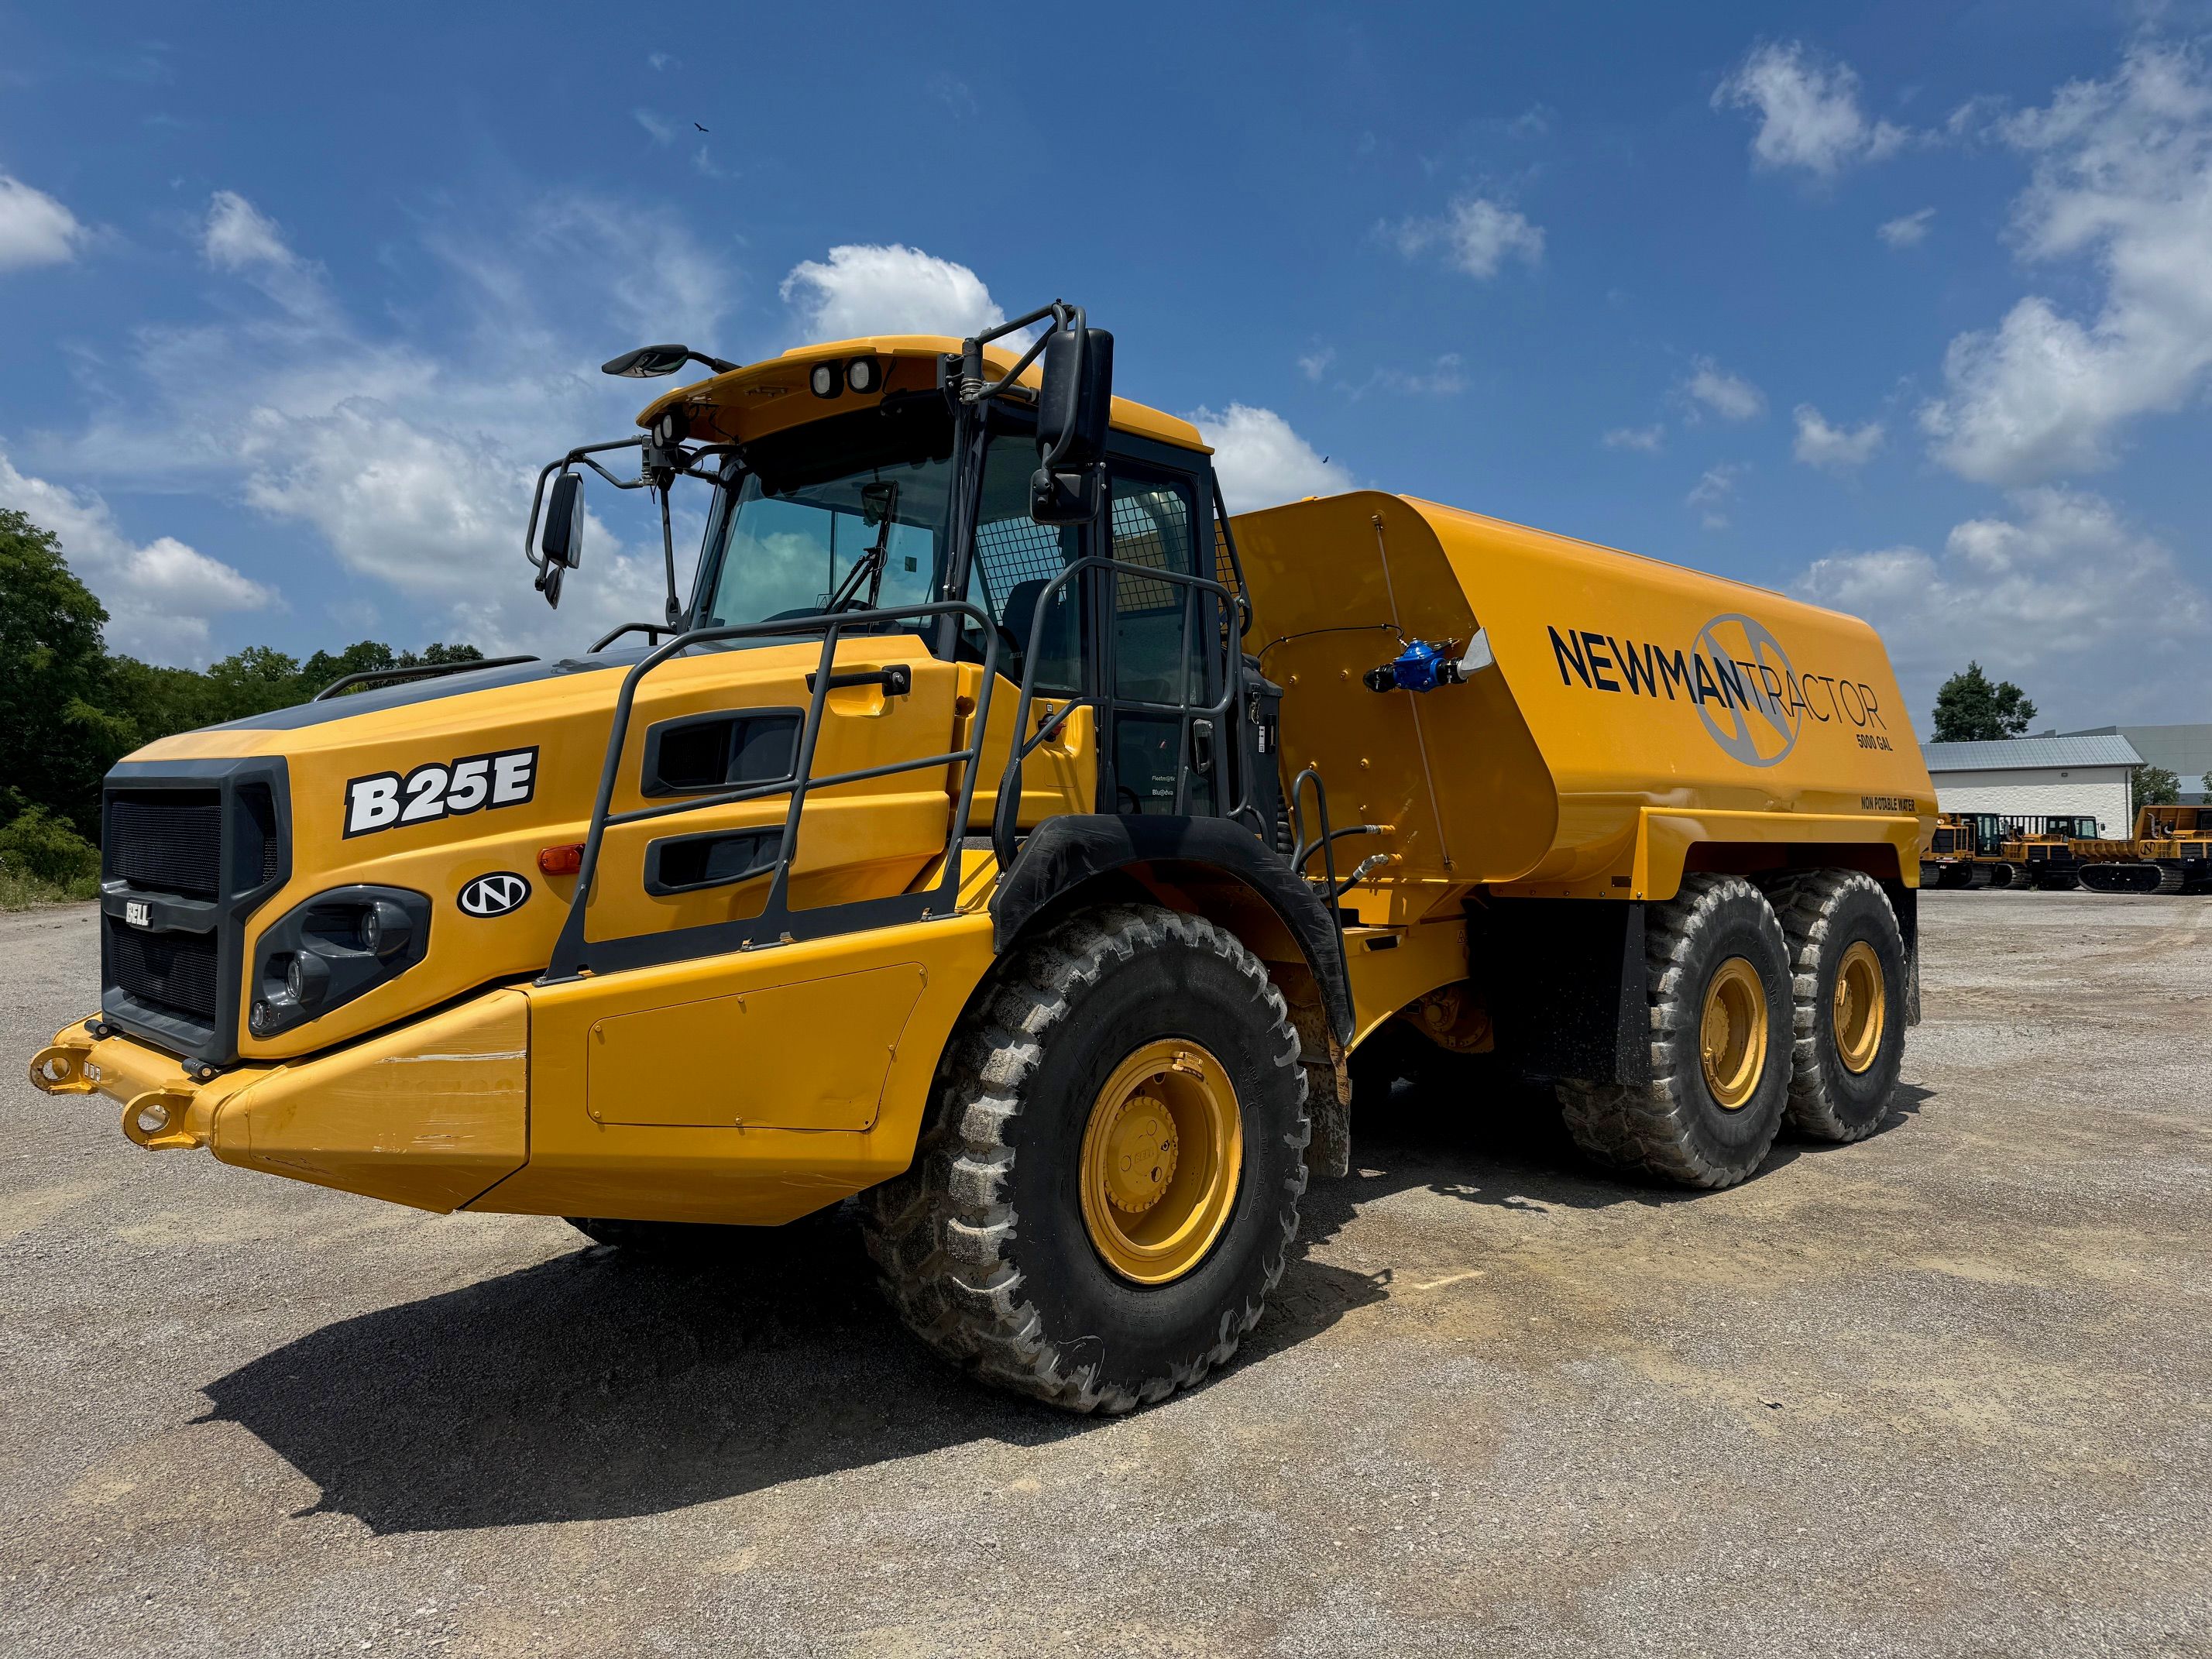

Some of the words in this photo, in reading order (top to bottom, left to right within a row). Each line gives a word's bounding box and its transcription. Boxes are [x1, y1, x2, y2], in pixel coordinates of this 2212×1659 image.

[1856, 733, 1877, 750] 5000
[1877, 736, 1894, 751] GAL
[347, 750, 535, 835] B25E
[1861, 796, 1874, 810] NON
[1874, 797, 1898, 812] POTABLE
[1898, 799, 1915, 812] WATER
[125, 902, 149, 926] BELL
